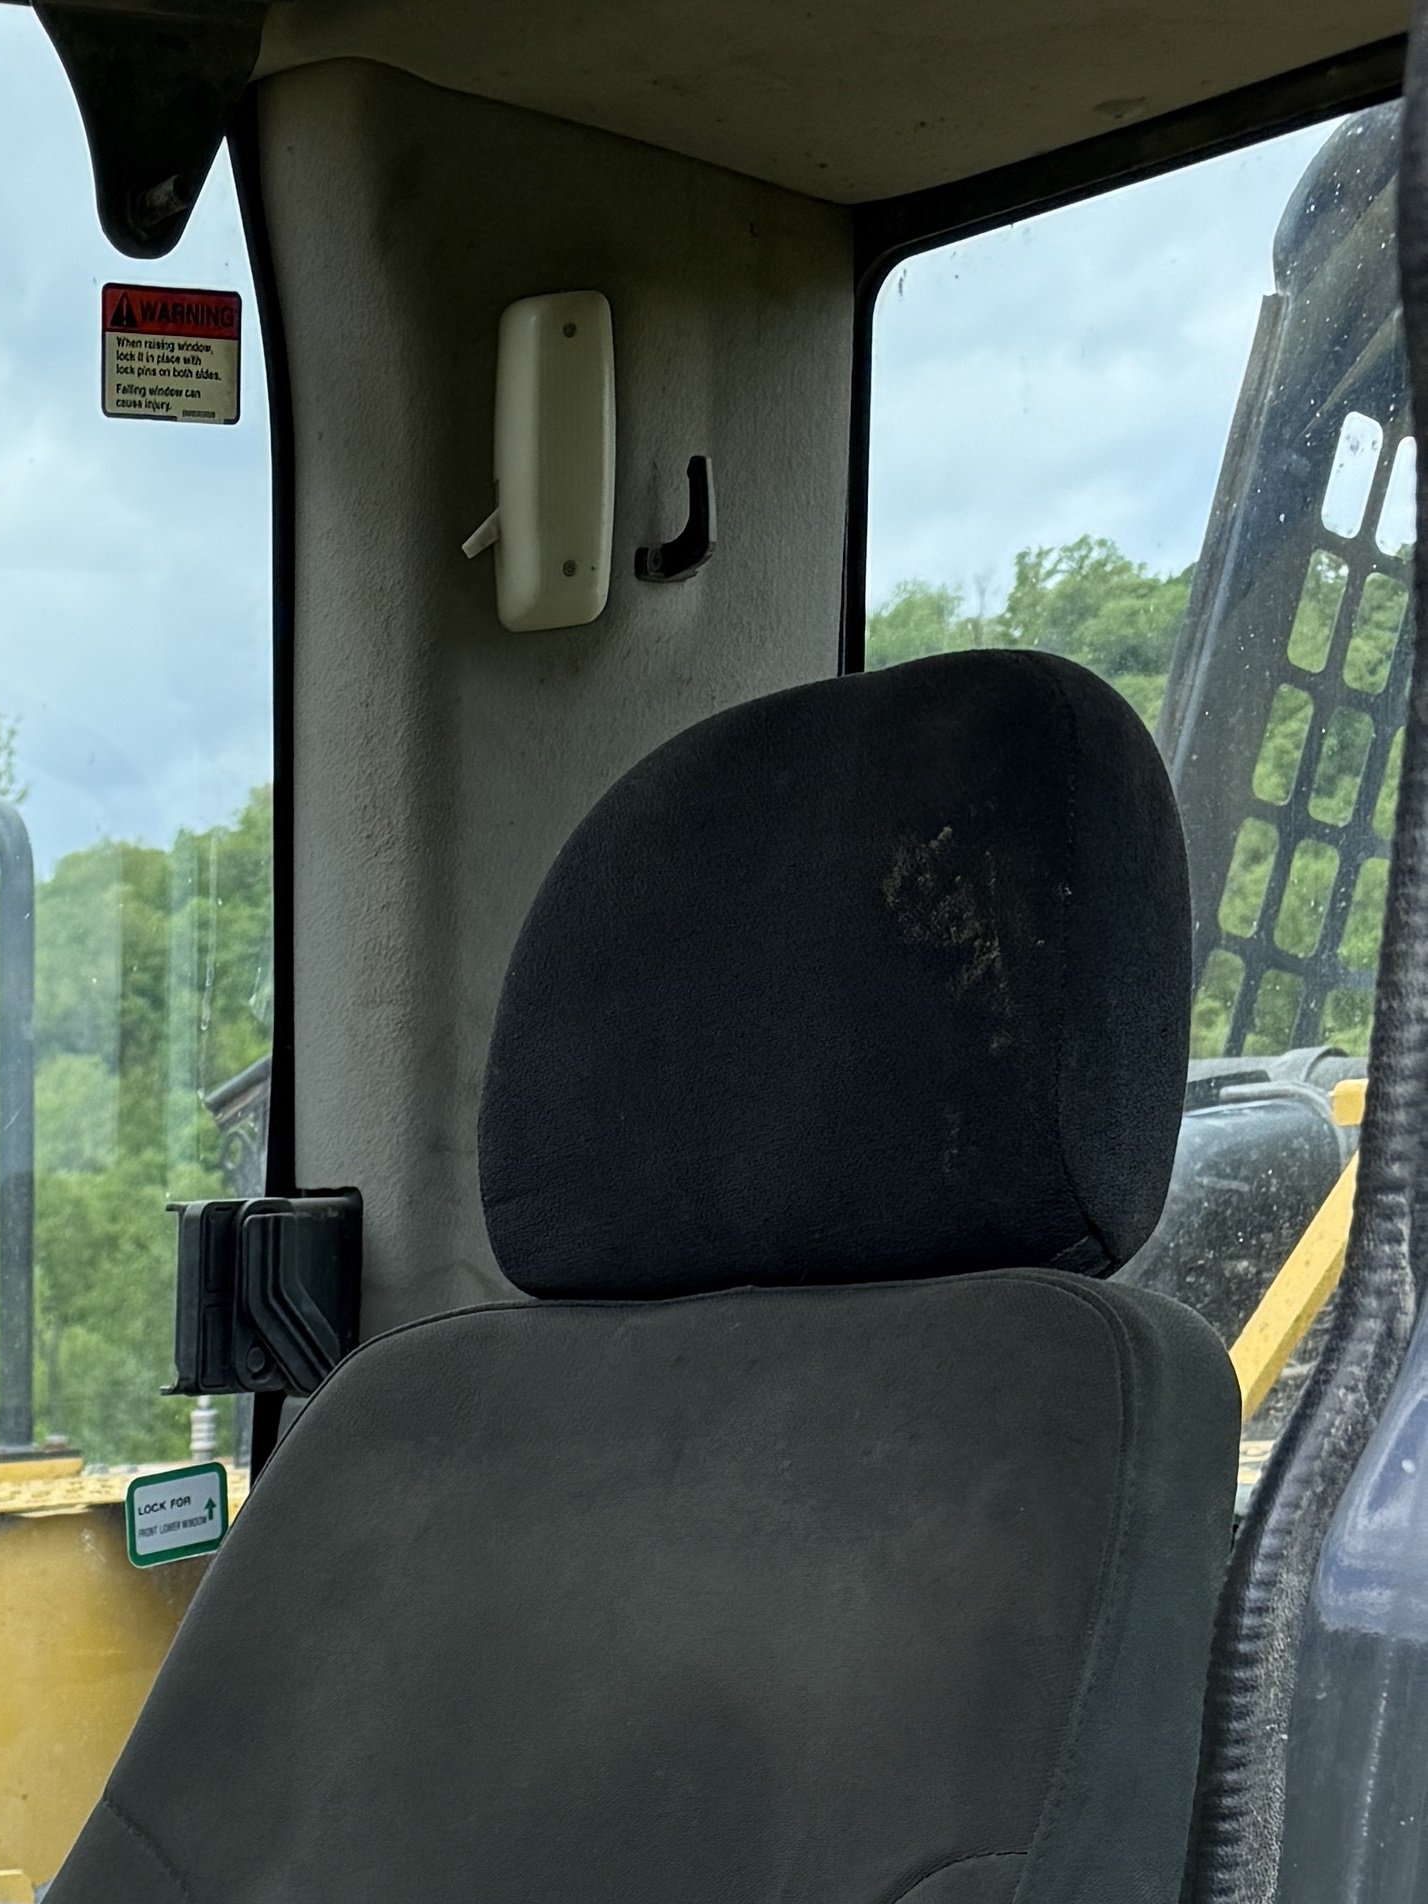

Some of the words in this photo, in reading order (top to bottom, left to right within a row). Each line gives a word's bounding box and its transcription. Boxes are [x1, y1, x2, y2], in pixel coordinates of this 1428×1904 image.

[140, 300, 234, 328] WARNING
[138, 1501, 166, 1515] LOCK
[171, 1496, 191, 1509] FOR
